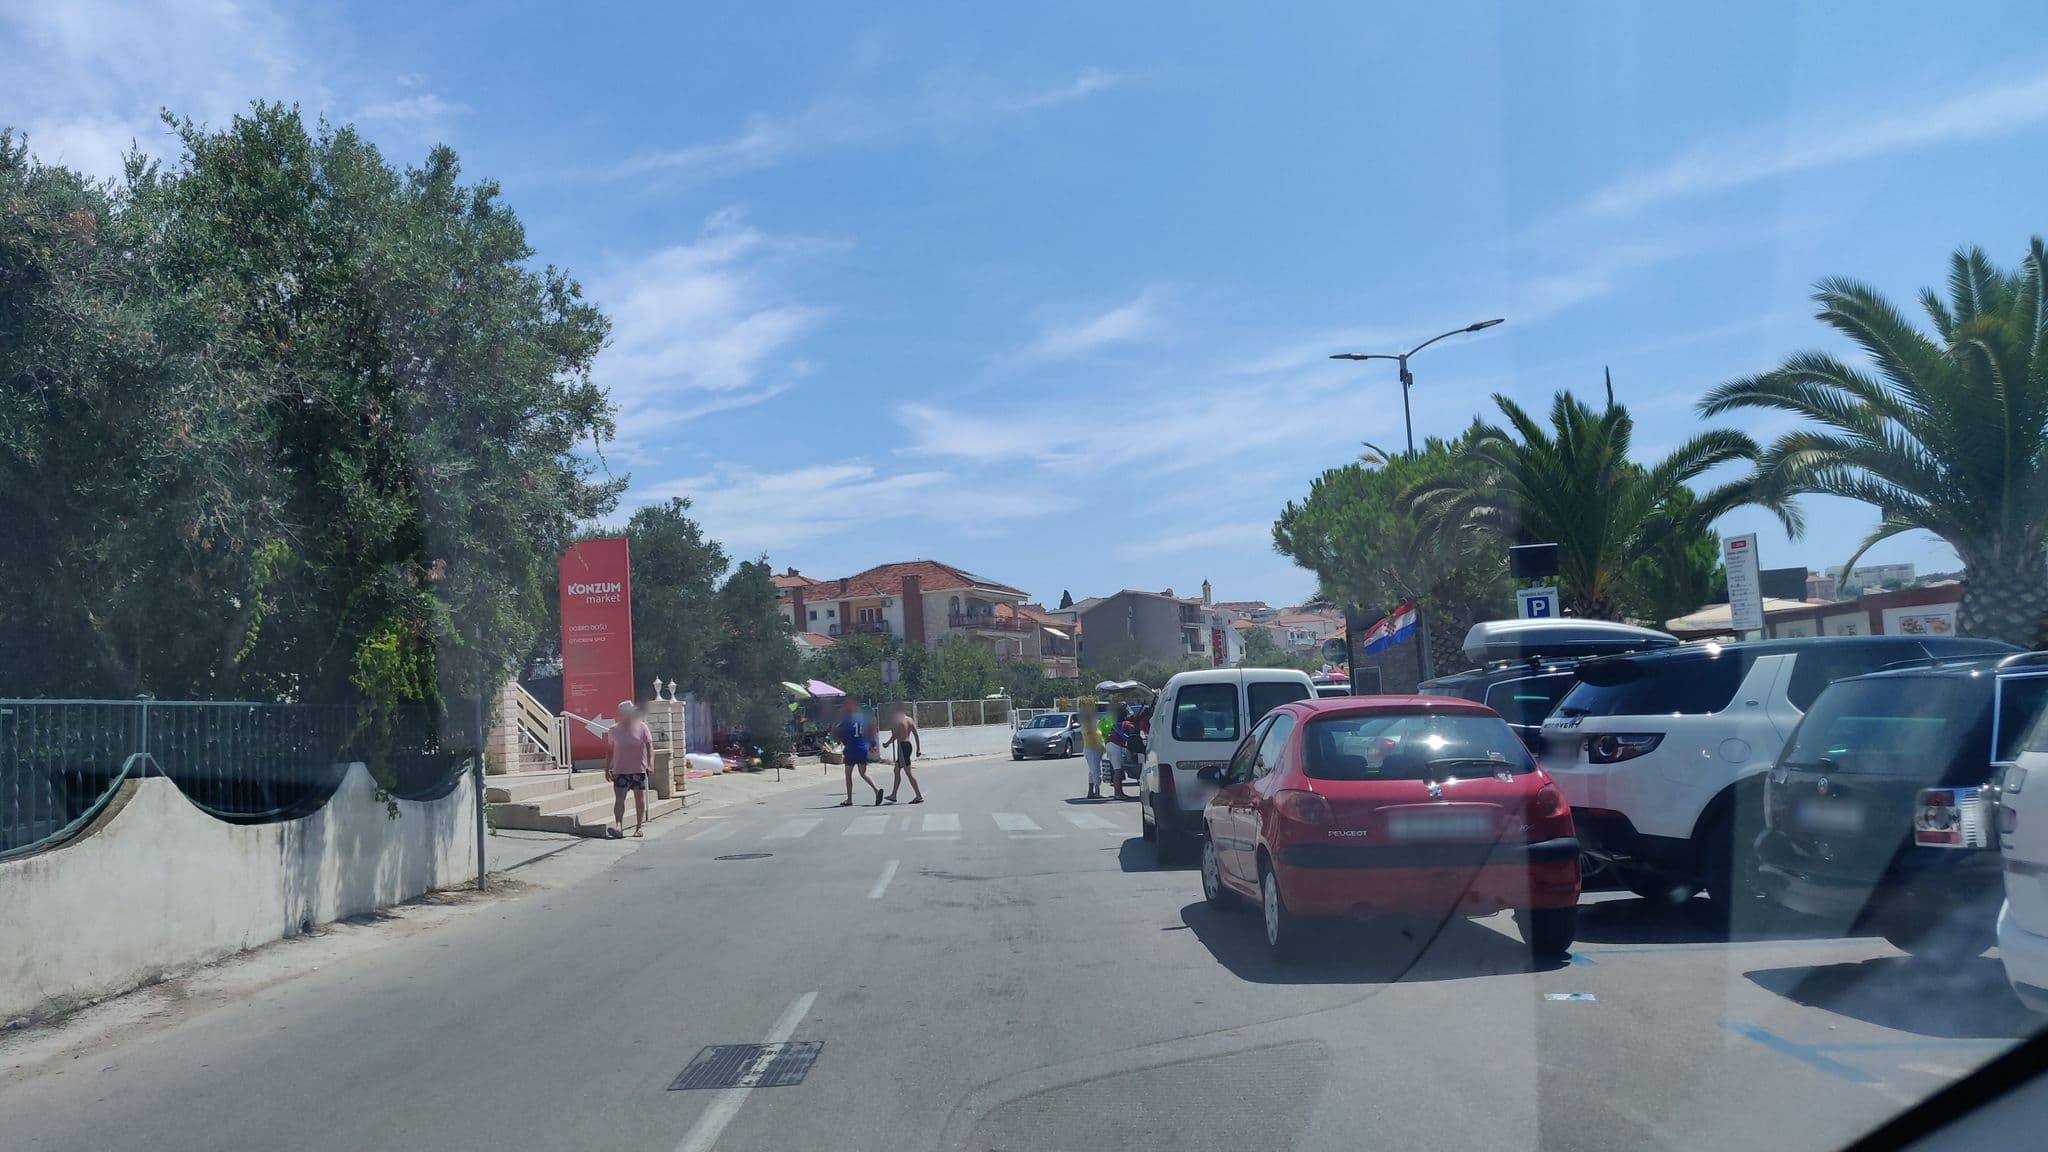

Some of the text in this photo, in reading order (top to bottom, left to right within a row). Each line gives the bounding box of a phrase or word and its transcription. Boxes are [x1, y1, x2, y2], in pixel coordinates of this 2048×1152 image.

[567, 582, 621, 594] KONZUM
[586, 593, 621, 604] market
[1532, 600, 1546, 617] P
